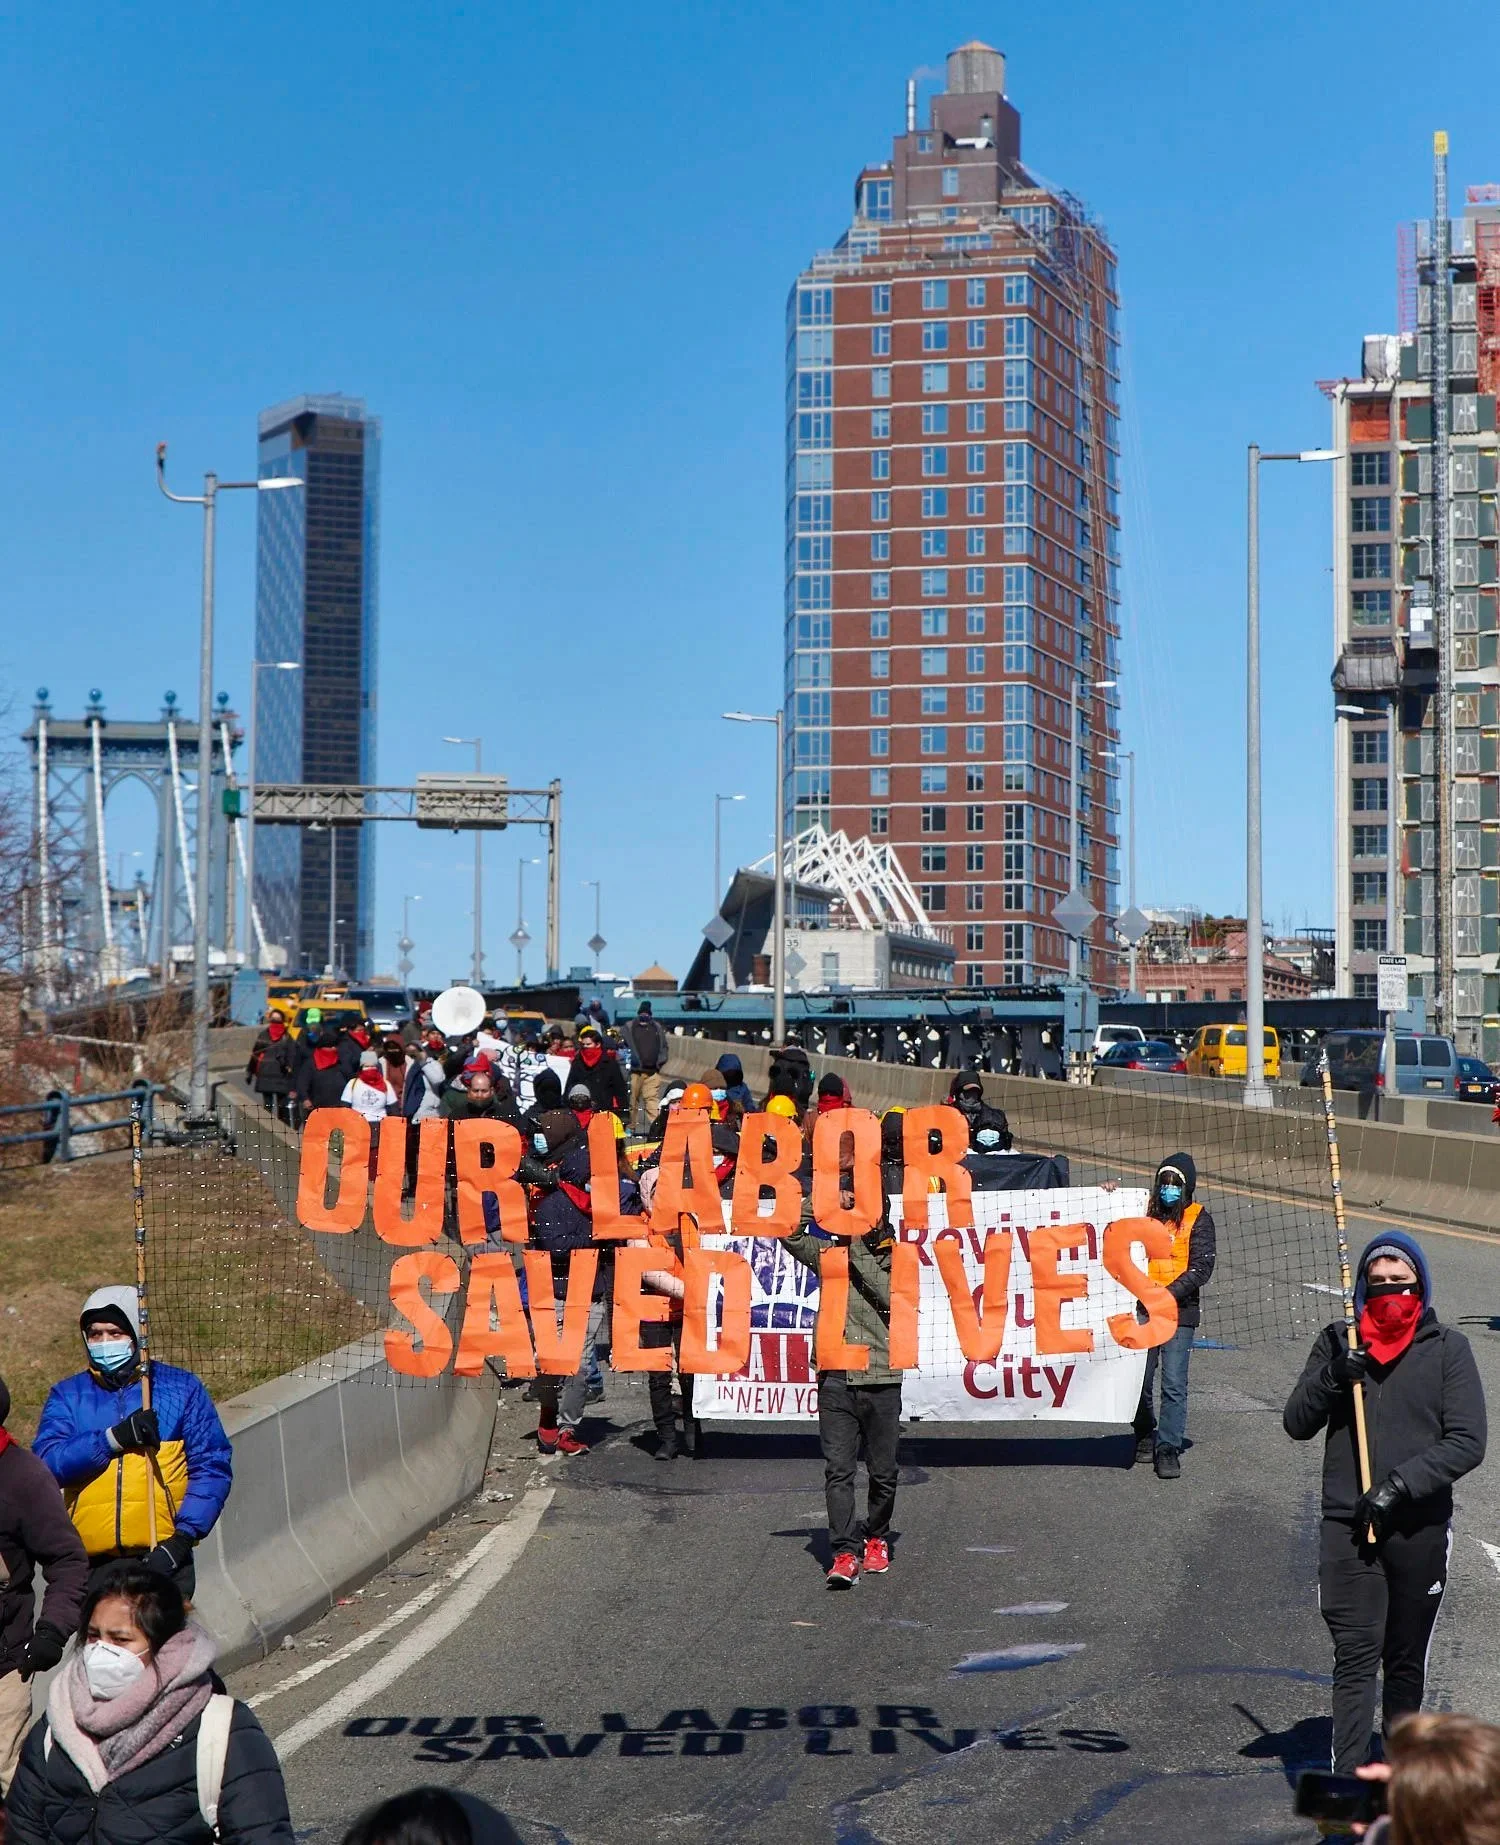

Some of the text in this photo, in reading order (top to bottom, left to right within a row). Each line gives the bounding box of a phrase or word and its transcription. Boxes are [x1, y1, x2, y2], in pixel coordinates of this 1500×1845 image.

[786, 939, 799, 947] 35
[296, 1104, 974, 1246] OUR LABOR
[384, 1216, 1179, 1378] SAVED LIVES
[718, 1386, 819, 1414] IN NEW YO
[963, 1353, 1076, 1408] City
